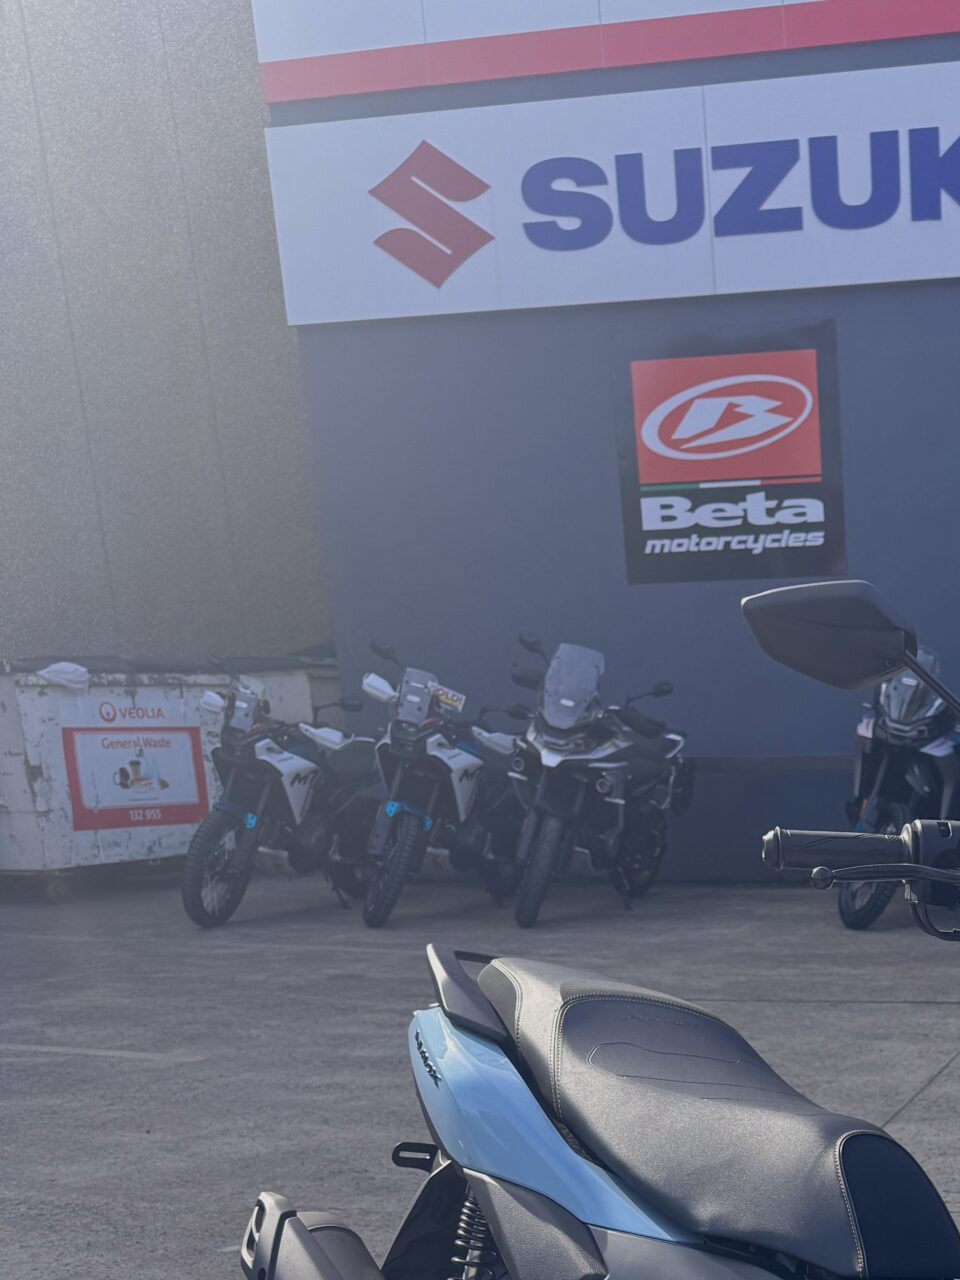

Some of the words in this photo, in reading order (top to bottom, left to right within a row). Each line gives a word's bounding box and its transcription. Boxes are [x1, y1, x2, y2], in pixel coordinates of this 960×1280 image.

[640, 491, 825, 531] Beta
[645, 529, 825, 555] motorcycles
[119, 707, 164, 719] VEOLIA
[102, 738, 139, 750] General
[143, 737, 171, 749] Waste
[129, 809, 143, 821] 132
[145, 808, 161, 820] 955
